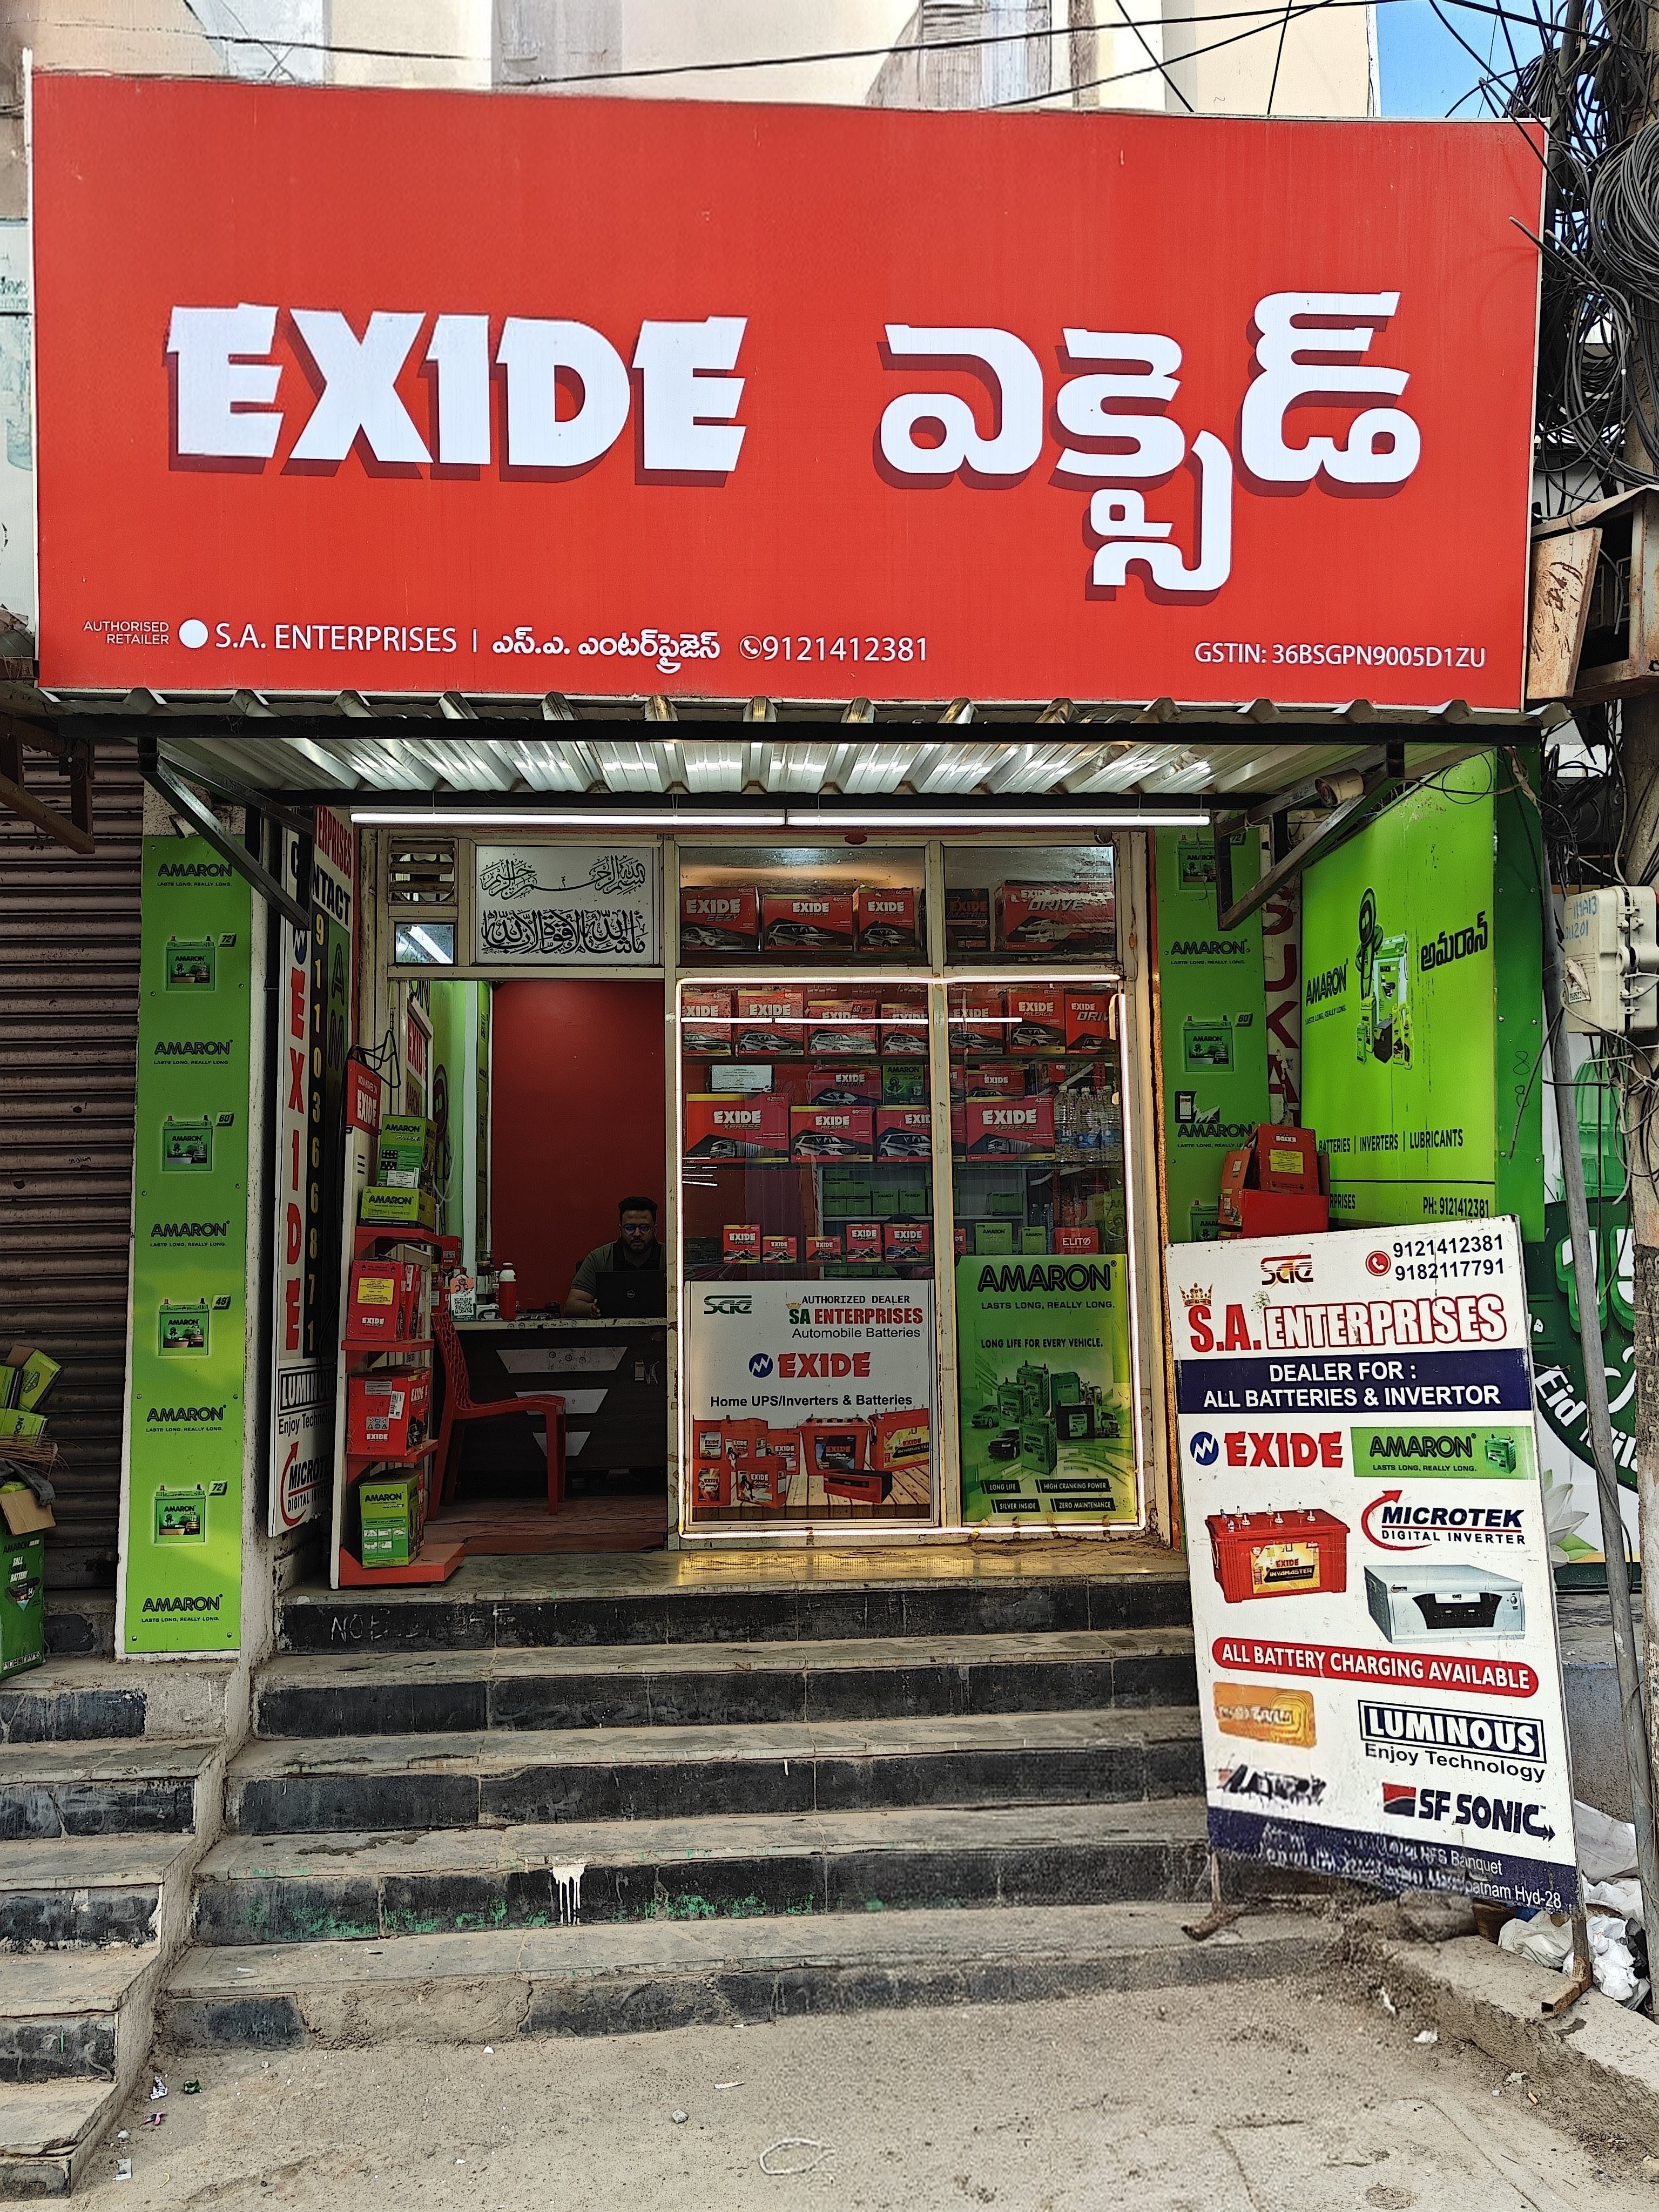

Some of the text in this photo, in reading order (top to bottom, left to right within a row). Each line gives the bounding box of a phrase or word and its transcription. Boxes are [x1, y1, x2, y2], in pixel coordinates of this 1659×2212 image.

[164, 303, 748, 474] EXIDE
[83, 621, 170, 632] AUTHORISED
[106, 633, 170, 645] RETAILER
[215, 623, 456, 652] S.A. ENTERPRISES
[763, 637, 927, 661] 9121412381
[1195, 643, 1485, 667] GSTIN: 36BSGPN9005D1ZU
[158, 864, 232, 877] AMARON
[292, 841, 350, 926] CNTACT
[685, 898, 741, 913] EXIDE
[792, 902, 830, 913] EXIDE
[867, 901, 905, 912] EXIDE
[950, 901, 987, 912] EXIDE
[1028, 900, 1084, 911] DRIVE
[1171, 941, 1245, 955] AMARON
[1421, 911, 1488, 972] అమరాన్
[1305, 969, 1347, 1007] AMARON
[748, 1004, 791, 1016] EXIDE
[852, 1004, 860, 1013] 60
[953, 1008, 989, 1017] EXIDE
[1018, 1002, 1054, 1012] EXIDE
[1076, 1011, 1109, 1021] DRIV
[155, 1041, 230, 1055] AMARON
[835, 1074, 865, 1083] EXIDE
[357, 1090, 377, 1127] EXIDE
[713, 1110, 762, 1124] EXIDE
[815, 1116, 850, 1125] EXIDE
[982, 1109, 1037, 1125] EXIDE
[385, 1124, 420, 1132] AMARON
[1177, 1123, 1252, 1138] AMARON
[1319, 1128, 1464, 1154] BATTERIES INVERTERS LUBRICANTS
[285, 966, 306, 1351] EXIDE
[369, 1195, 412, 1205] AMARON
[1330, 1194, 1356, 1210] RPRISES
[1424, 1196, 1489, 1219] PH: 9121412381
[151, 1223, 227, 1237] AMARON
[729, 1232, 756, 1242] EXIDE
[852, 1230, 877, 1238] EXIDE
[894, 1230, 922, 1239] EXIDE
[1393, 1234, 1503, 1258] 9121412381
[977, 1263, 1111, 1292] AMARON
[1395, 1258, 1504, 1282] 9182117791
[801, 1296, 911, 1304] AUTHORIZED DEALER
[789, 1308, 923, 1325] SA ENTERPRISES
[1188, 1293, 1508, 1353] S.A. ENTERPRISES
[792, 1327, 921, 1338] Automobile Batteries
[981, 1338, 1103, 1348] LONG LIFE FOR EVERY VEHICLE.
[778, 1352, 871, 1378] EXIDE
[1270, 1362, 1405, 1382] DEALER FOR
[411, 1388, 423, 1402] EXIDE
[710, 1394, 912, 1407] Home UPS/Inverters & Batteries
[1203, 1385, 1501, 1408] ALL BATTERIES & INVERTOR
[1535, 1365, 1588, 1427] Eid
[147, 1407, 223, 1422] AMARON
[279, 1419, 300, 1437] Enjoy
[1224, 1431, 1343, 1468] EXIDE
[1369, 1435, 1473, 1459] AMARON
[288, 1456, 332, 1490] MICROT
[288, 1492, 309, 1512] DIGITAL
[365, 1493, 402, 1502] AMARON
[1382, 1506, 1524, 1528] MICROTEK
[1382, 1530, 1526, 1545] DIGITAL INVERTER
[1276, 1559, 1299, 1567] EXIDE
[1270, 1568, 1312, 1577] INVAMASTER
[143, 1596, 220, 1612] AMARON
[1222, 1642, 1530, 1690] ALL BATTERY CHARGING AVAILABLE
[1368, 1708, 1537, 1755] LUMINOUS
[1365, 1743, 1545, 1783] Enjoy Technology
[1419, 1788, 1547, 1838] SF SONIC
[1451, 1850, 1503, 1876] Banquet
[1515, 1885, 1561, 1909] Hyd-28
